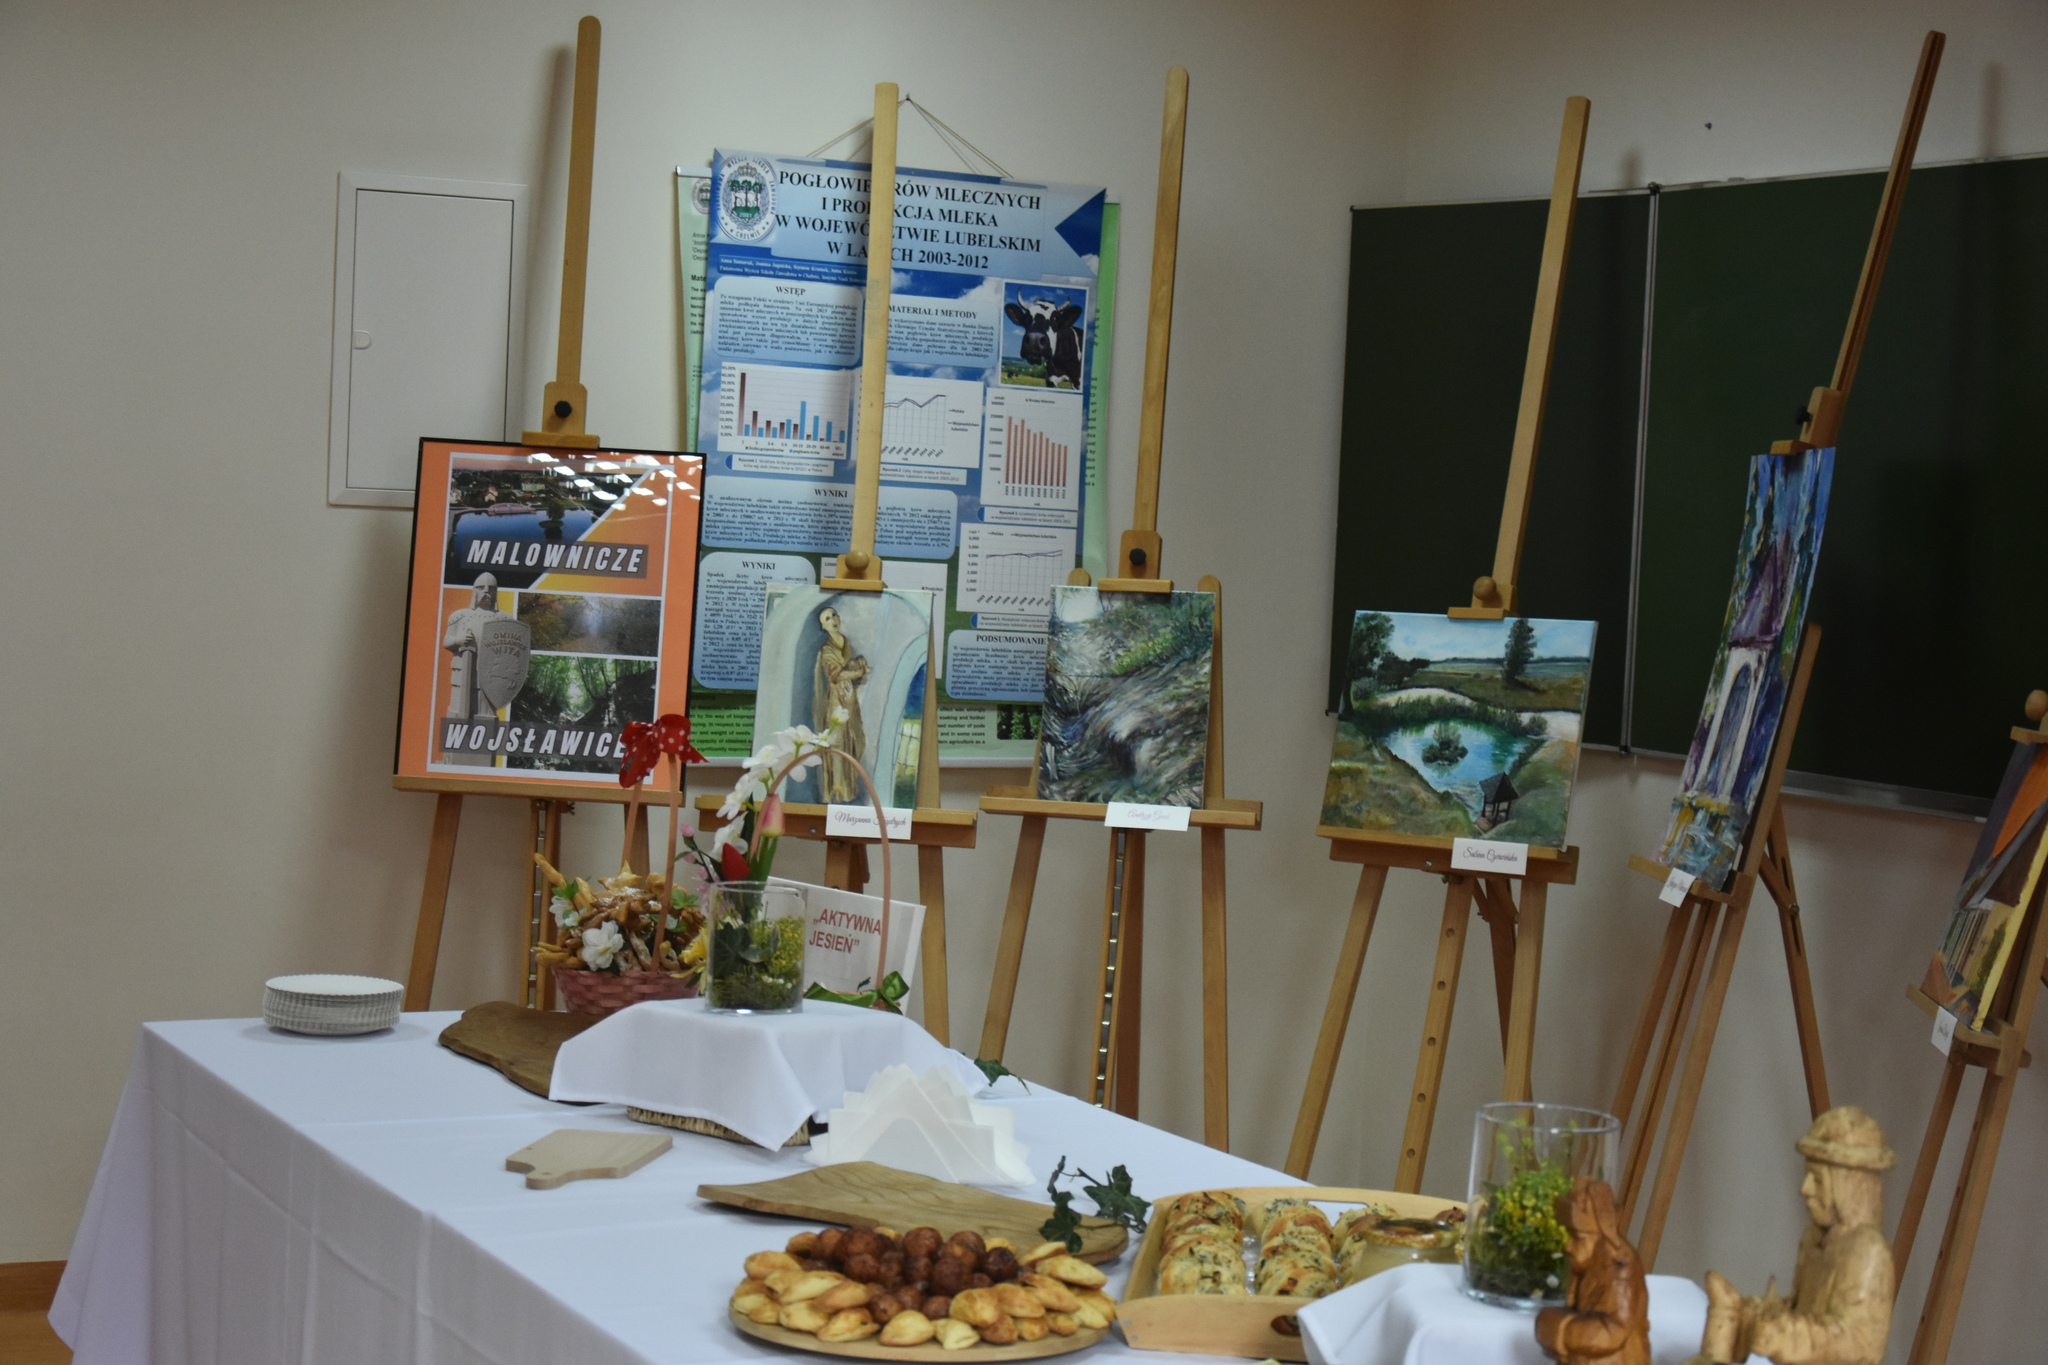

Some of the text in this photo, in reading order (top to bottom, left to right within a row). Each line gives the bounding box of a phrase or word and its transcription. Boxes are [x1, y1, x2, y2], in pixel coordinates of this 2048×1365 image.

[779, 170, 872, 193] POGŁOWIE
[935, 187, 1041, 210] MLECZNYCH
[821, 197, 827, 210] I
[938, 208, 998, 228] MLEKA
[775, 214, 791, 228] W
[945, 231, 1041, 253] LUBELSKIM
[827, 241, 843, 254] W
[918, 250, 989, 269] 2003-2012
[775, 286, 806, 297] WSTĘP
[940, 307, 978, 320] METODY
[814, 489, 848, 498] WYNIKI
[466, 539, 644, 574] MALOWNICZE
[742, 561, 776, 570] WYNIKI
[976, 634, 1047, 645] PODSUMOWANIE
[444, 723, 627, 759] WOJSŁAWICE
